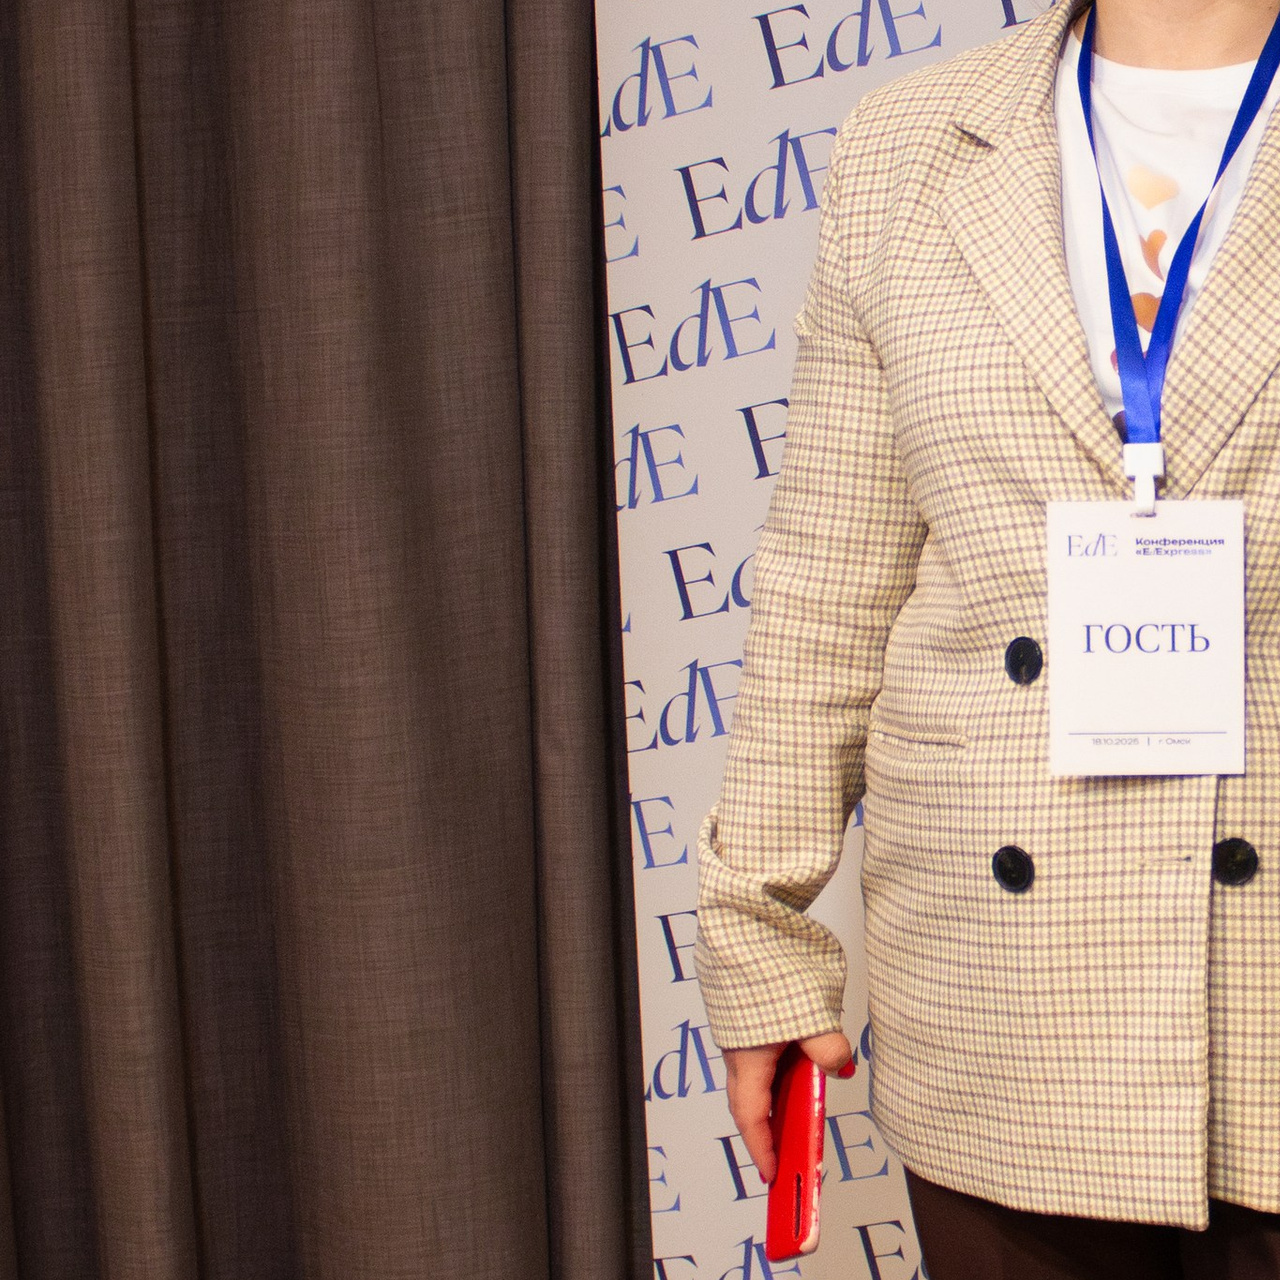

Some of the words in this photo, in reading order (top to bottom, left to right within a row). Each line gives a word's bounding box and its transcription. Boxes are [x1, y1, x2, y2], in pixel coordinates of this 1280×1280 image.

[599, 33, 714, 139] dE
[609, 276, 777, 386] EdE
[613, 422, 699, 512] dE
[1135, 536, 1225, 548] Конференция
[1082, 623, 1211, 655] ГОСТЬ
[714, 1108, 890, 1202] EE
